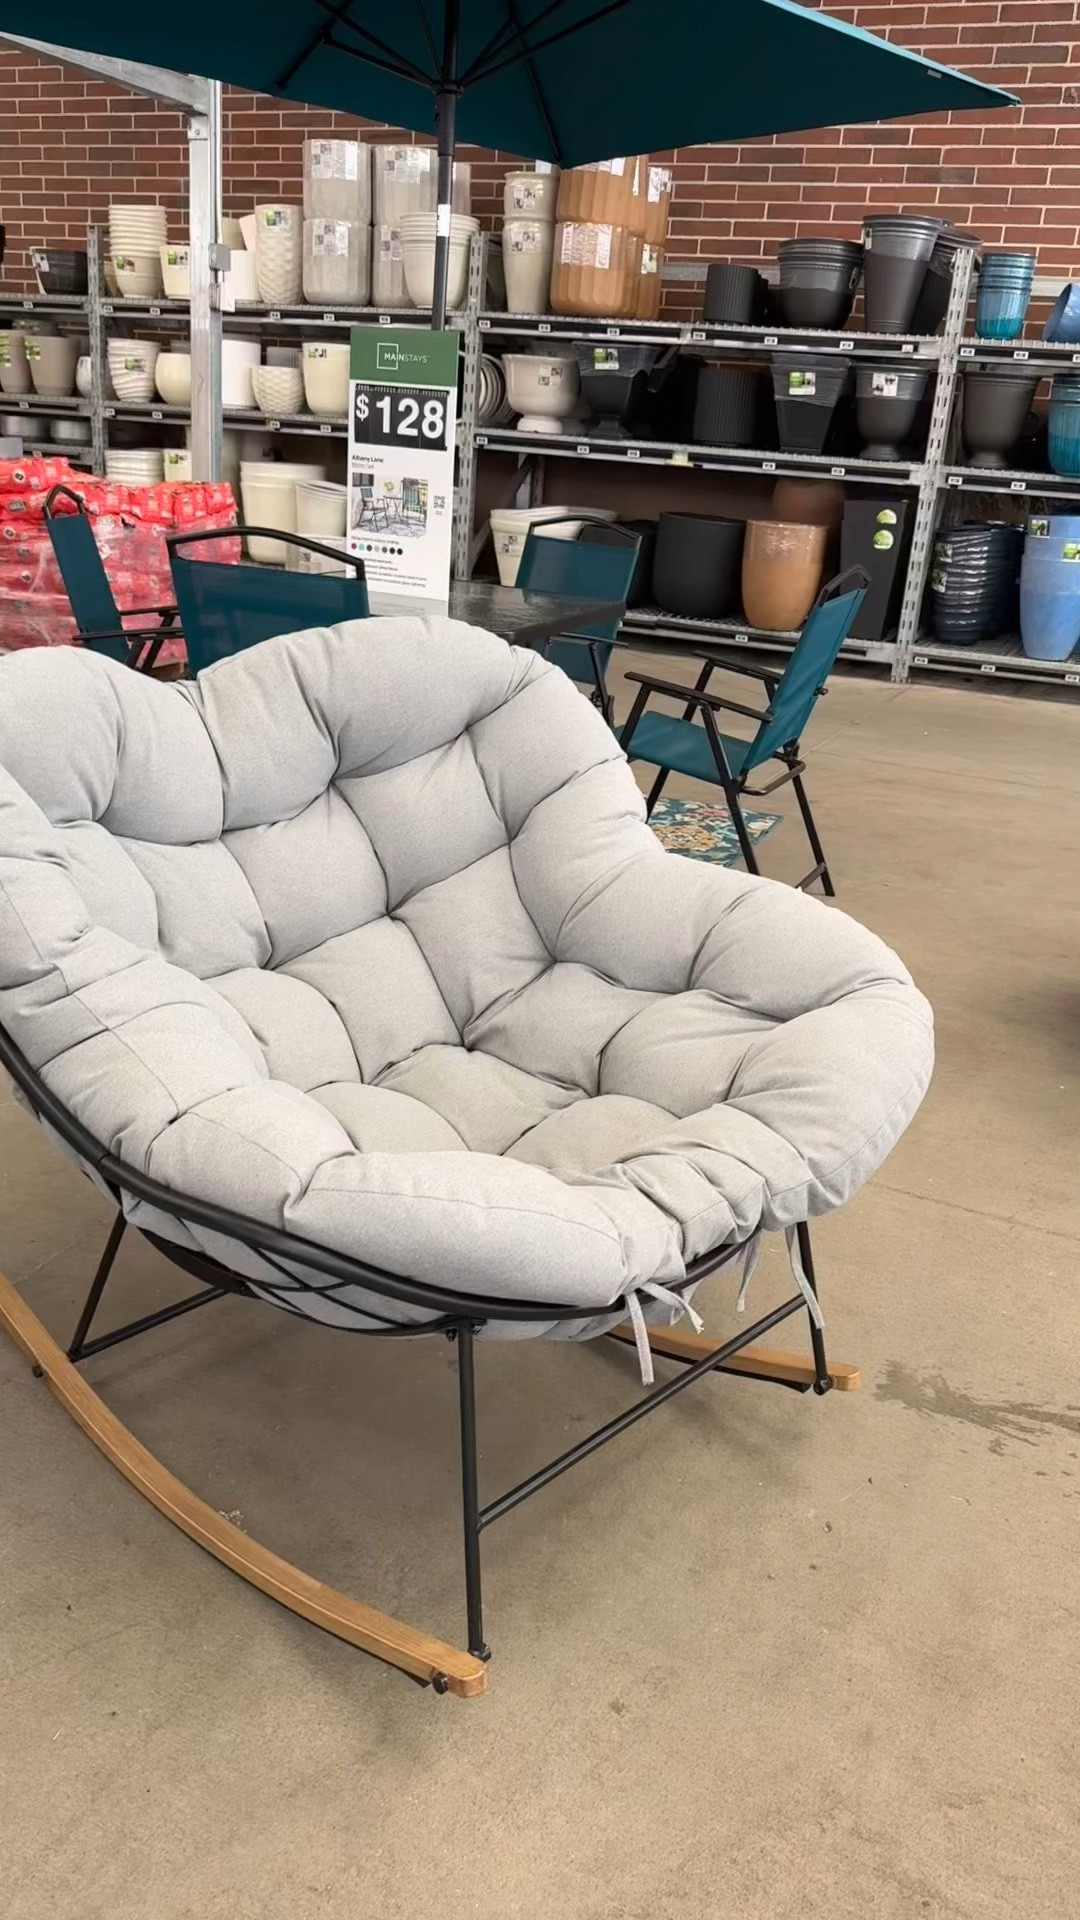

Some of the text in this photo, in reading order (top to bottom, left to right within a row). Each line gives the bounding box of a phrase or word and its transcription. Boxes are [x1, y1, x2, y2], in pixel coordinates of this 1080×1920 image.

[384, 352, 428, 364] MAINSTAYS
[355, 393, 444, 439] $128
[351, 454, 370, 463] Albany
